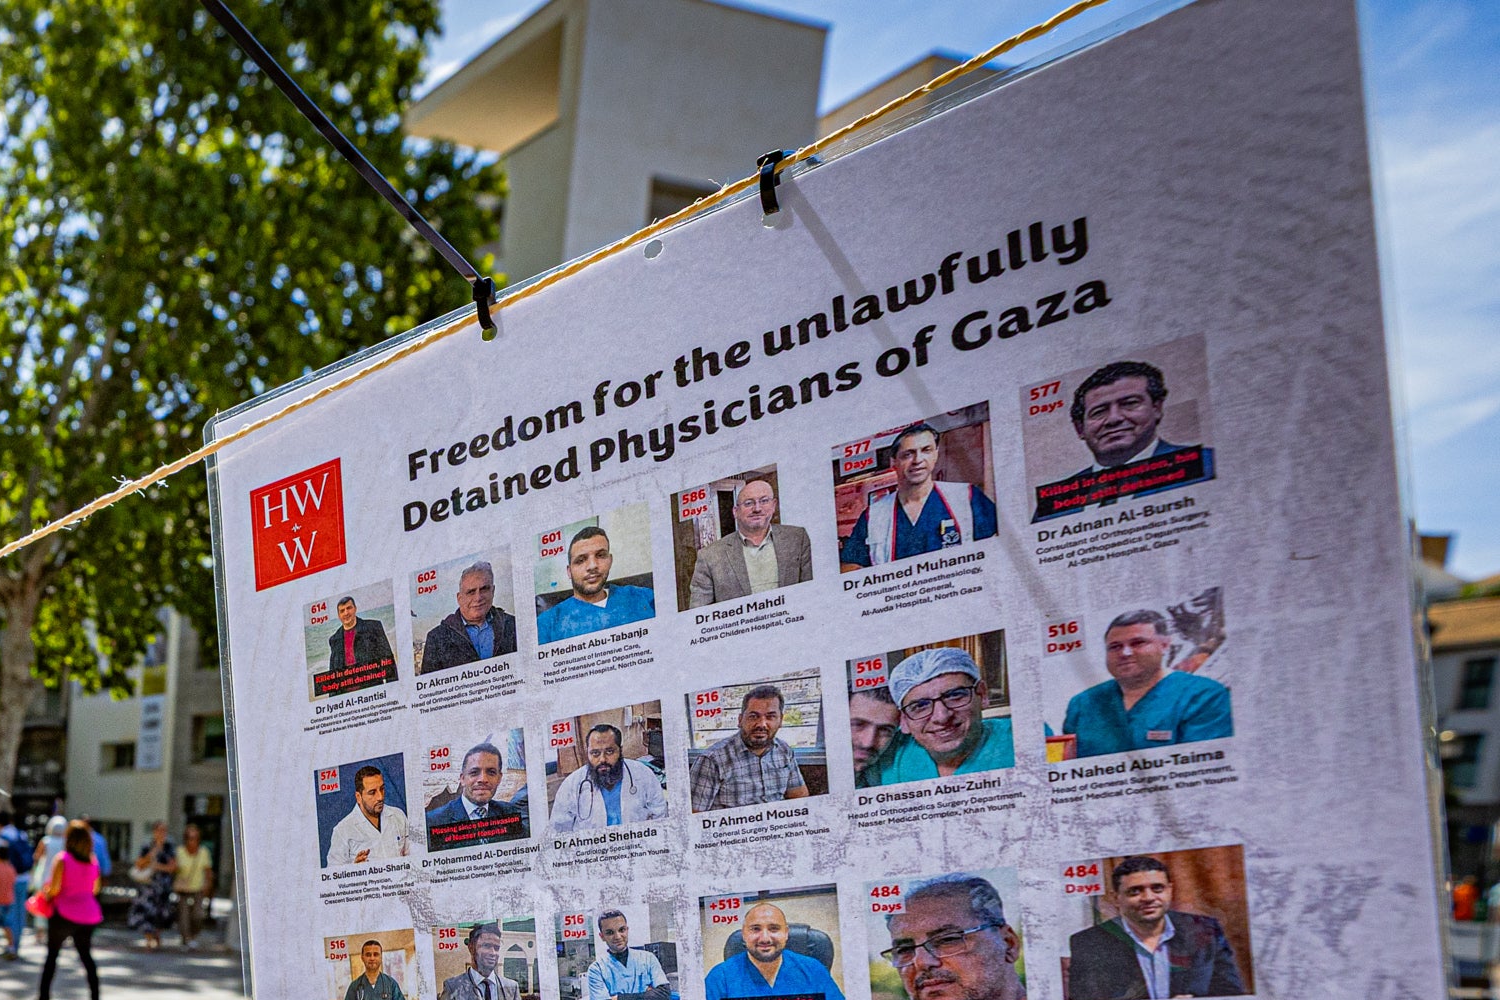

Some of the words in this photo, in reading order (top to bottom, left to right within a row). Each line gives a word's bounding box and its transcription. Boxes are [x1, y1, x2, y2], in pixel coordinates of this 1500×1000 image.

[408, 400, 584, 482] Freedom
[593, 369, 664, 417] for
[674, 340, 751, 389] the
[762, 216, 1092, 356] unlawfully
[1030, 381, 1060, 401] 577
[402, 451, 581, 532] Detained
[590, 357, 863, 472] Physicians
[875, 326, 936, 377] of
[952, 279, 1113, 352] Gaza
[1030, 398, 1064, 416] Days
[844, 440, 870, 458] 577
[844, 455, 874, 472] Days
[262, 472, 330, 529] HW
[682, 489, 706, 505] 586
[682, 504, 708, 518] Days
[1037, 527, 1056, 542] Dr
[1059, 515, 1114, 537] Adnan
[1118, 496, 1195, 524] Al-Bursh
[541, 531, 561, 544] 601
[541, 544, 564, 557] Days
[417, 570, 436, 583] 602
[843, 577, 860, 592] Dr
[863, 566, 913, 590] Ahmed
[916, 550, 986, 574] Muhanna
[418, 582, 437, 594] Days
[959, 584, 983, 597] Gaza
[695, 612, 710, 625] Dr
[712, 604, 743, 622] Raed
[746, 595, 785, 614] Mahdi
[700, 620, 739, 634] Consultant
[720, 628, 749, 640] Children
[751, 620, 784, 634] Hospital,
[786, 614, 804, 626] Gaza
[1048, 622, 1079, 638] 516
[538, 650, 550, 660] Dr
[550, 641, 586, 658] Medhat
[588, 627, 648, 650] Abu-Tabanja
[1047, 639, 1082, 654] Days
[856, 658, 883, 674] 516
[416, 680, 428, 691] Dr
[429, 671, 458, 689] Akram
[460, 662, 510, 681] Abu-Odeh
[855, 674, 885, 689] Days
[1048, 769, 1067, 783] Dr
[1070, 760, 1126, 780] Nahed
[1130, 748, 1225, 772] Abu-Taima
[858, 794, 873, 806] Dr
[876, 787, 932, 804] Ghassan
[934, 777, 1001, 796] Abu-Zuhri
[702, 818, 717, 829] Dr
[719, 812, 762, 828] Ahmed
[766, 807, 809, 821] Mousa
[870, 885, 901, 899] 484
[709, 897, 741, 911] +513
[872, 900, 902, 915] Days
[712, 912, 738, 925] Days
